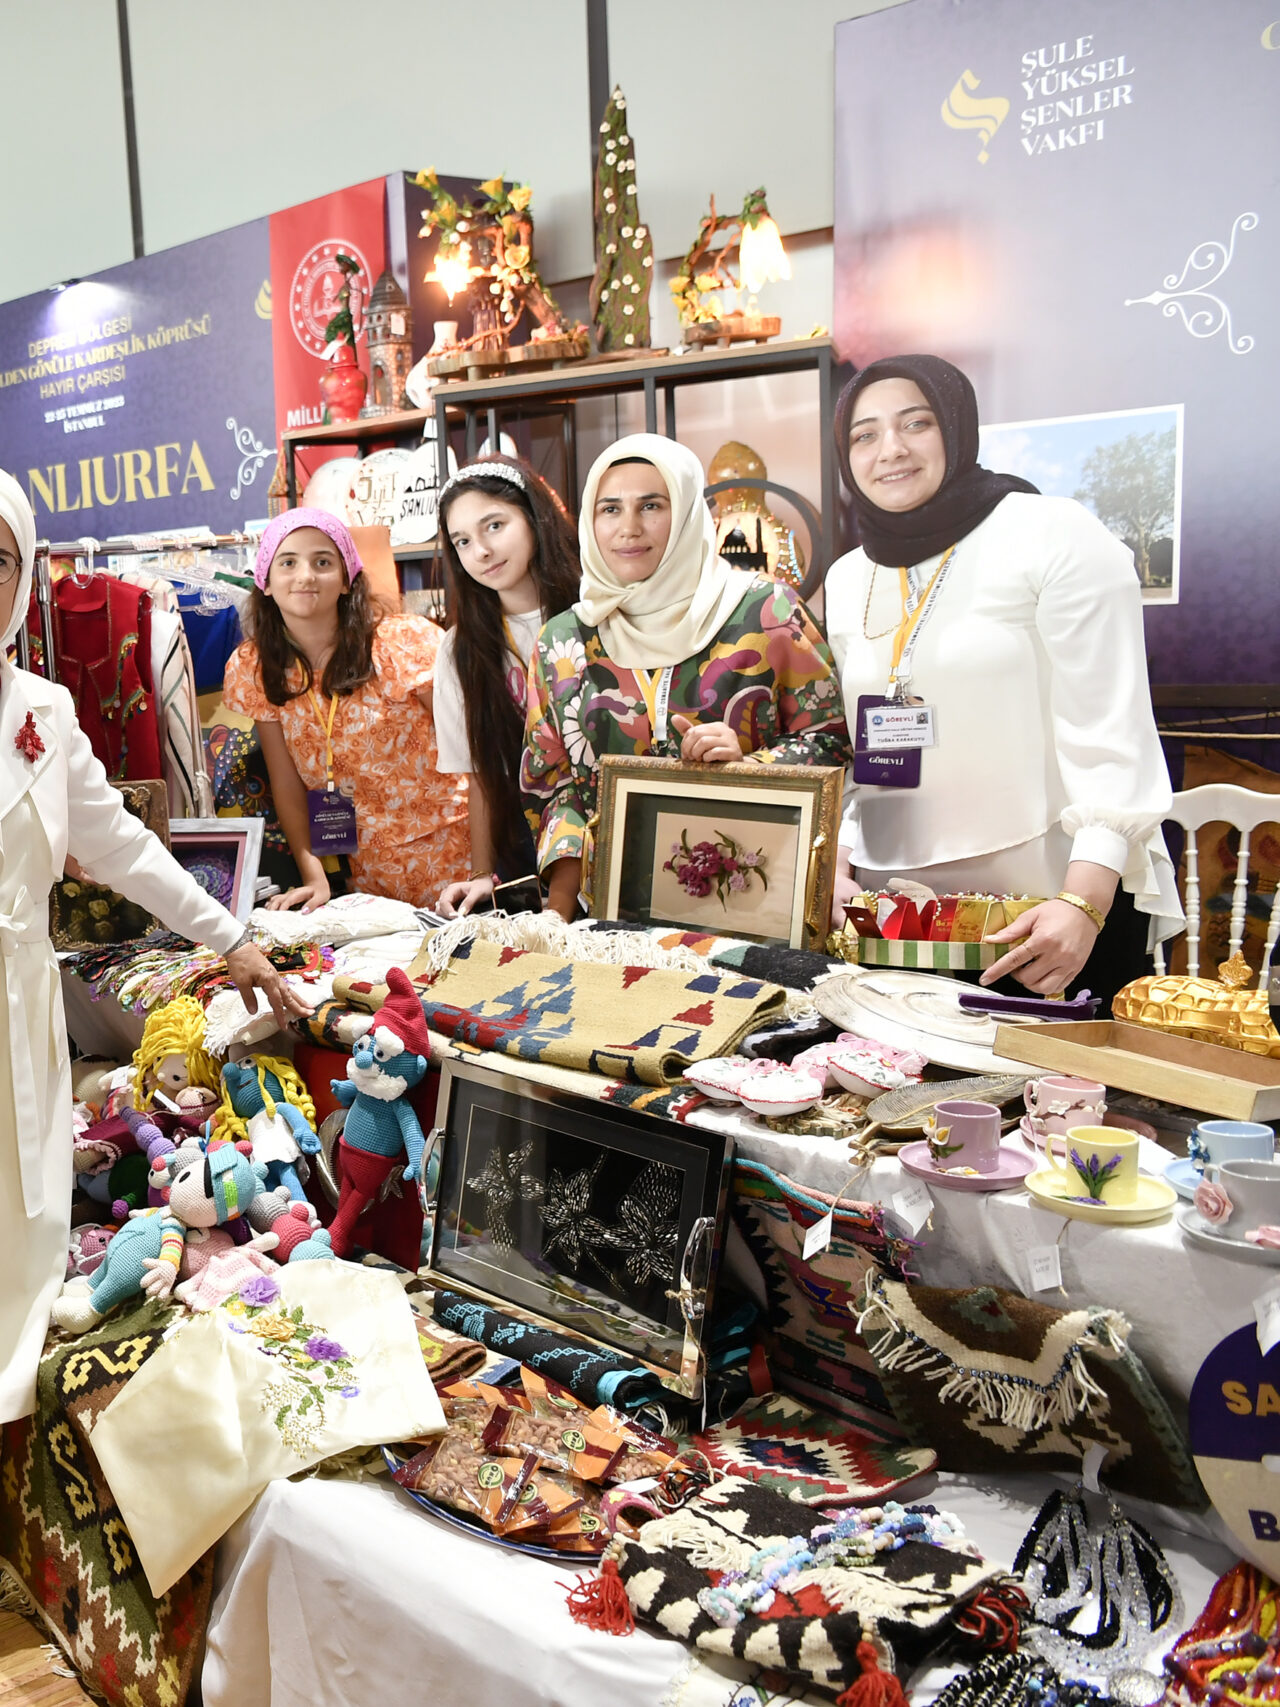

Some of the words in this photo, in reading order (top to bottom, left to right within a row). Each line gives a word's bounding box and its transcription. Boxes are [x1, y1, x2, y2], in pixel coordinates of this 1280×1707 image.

[1021, 34, 1094, 78] ŞULE
[1021, 54, 1135, 101] YÜKSEL
[1020, 84, 1133, 134] ŞENLER
[1020, 119, 1105, 156] VAKFI
[28, 354, 75, 380] GÖNÜLE
[75, 334, 146, 368] KARDEŞLİK
[147, 314, 211, 349] KÖPRÜSÜ
[40, 377, 75, 400] HAYIR
[77, 365, 126, 394] ÇARŞISI
[28, 439, 216, 516] NLIURFA
[868, 756, 904, 766] GÖREVLİ
